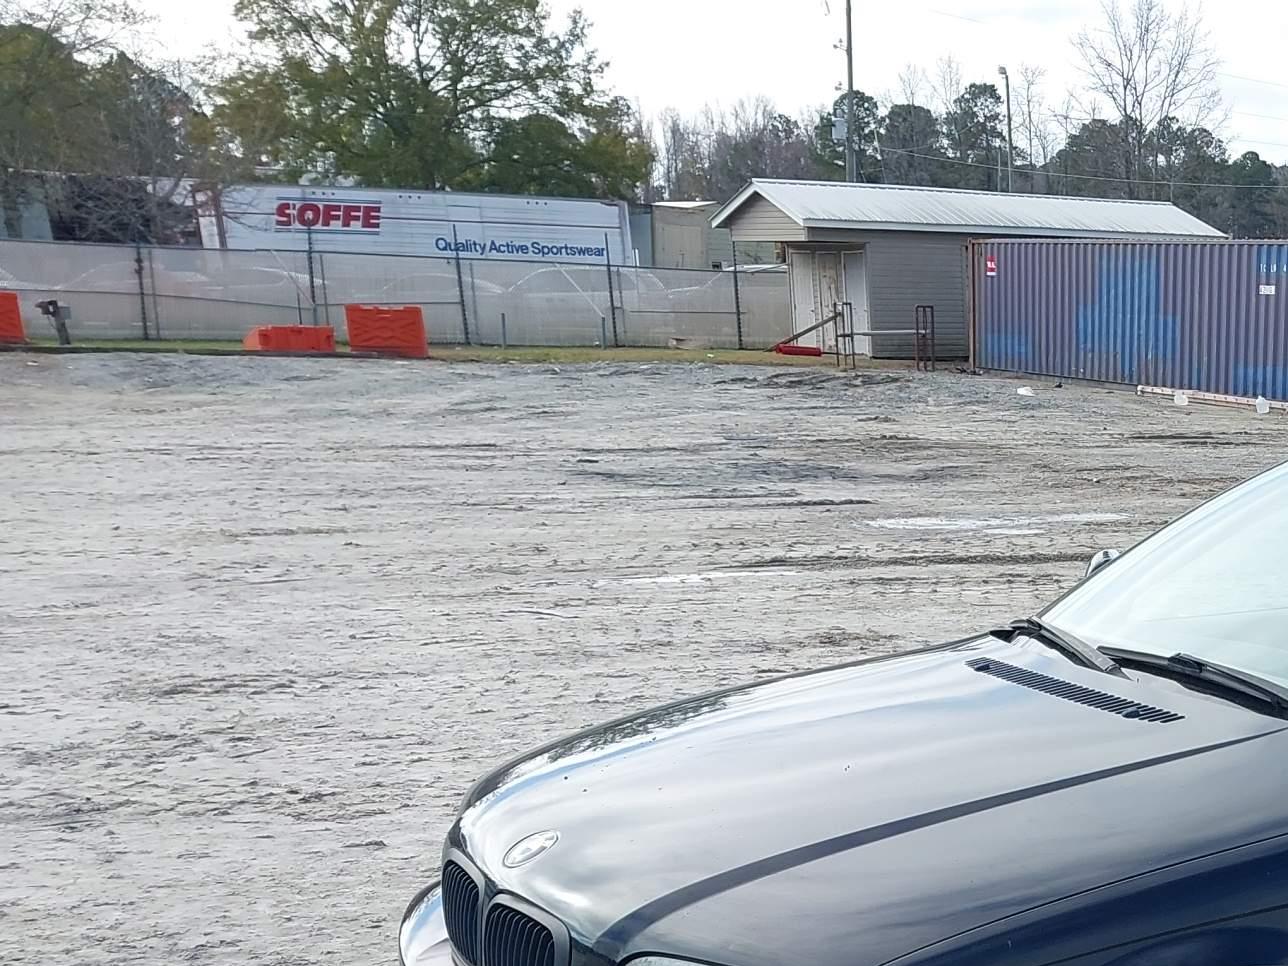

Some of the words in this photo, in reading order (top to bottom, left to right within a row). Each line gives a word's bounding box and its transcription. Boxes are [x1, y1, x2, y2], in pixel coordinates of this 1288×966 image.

[275, 202, 381, 229] SOFFE
[435, 237, 486, 256] Quality
[489, 239, 529, 255] Active
[531, 241, 605, 257] Sportswear
